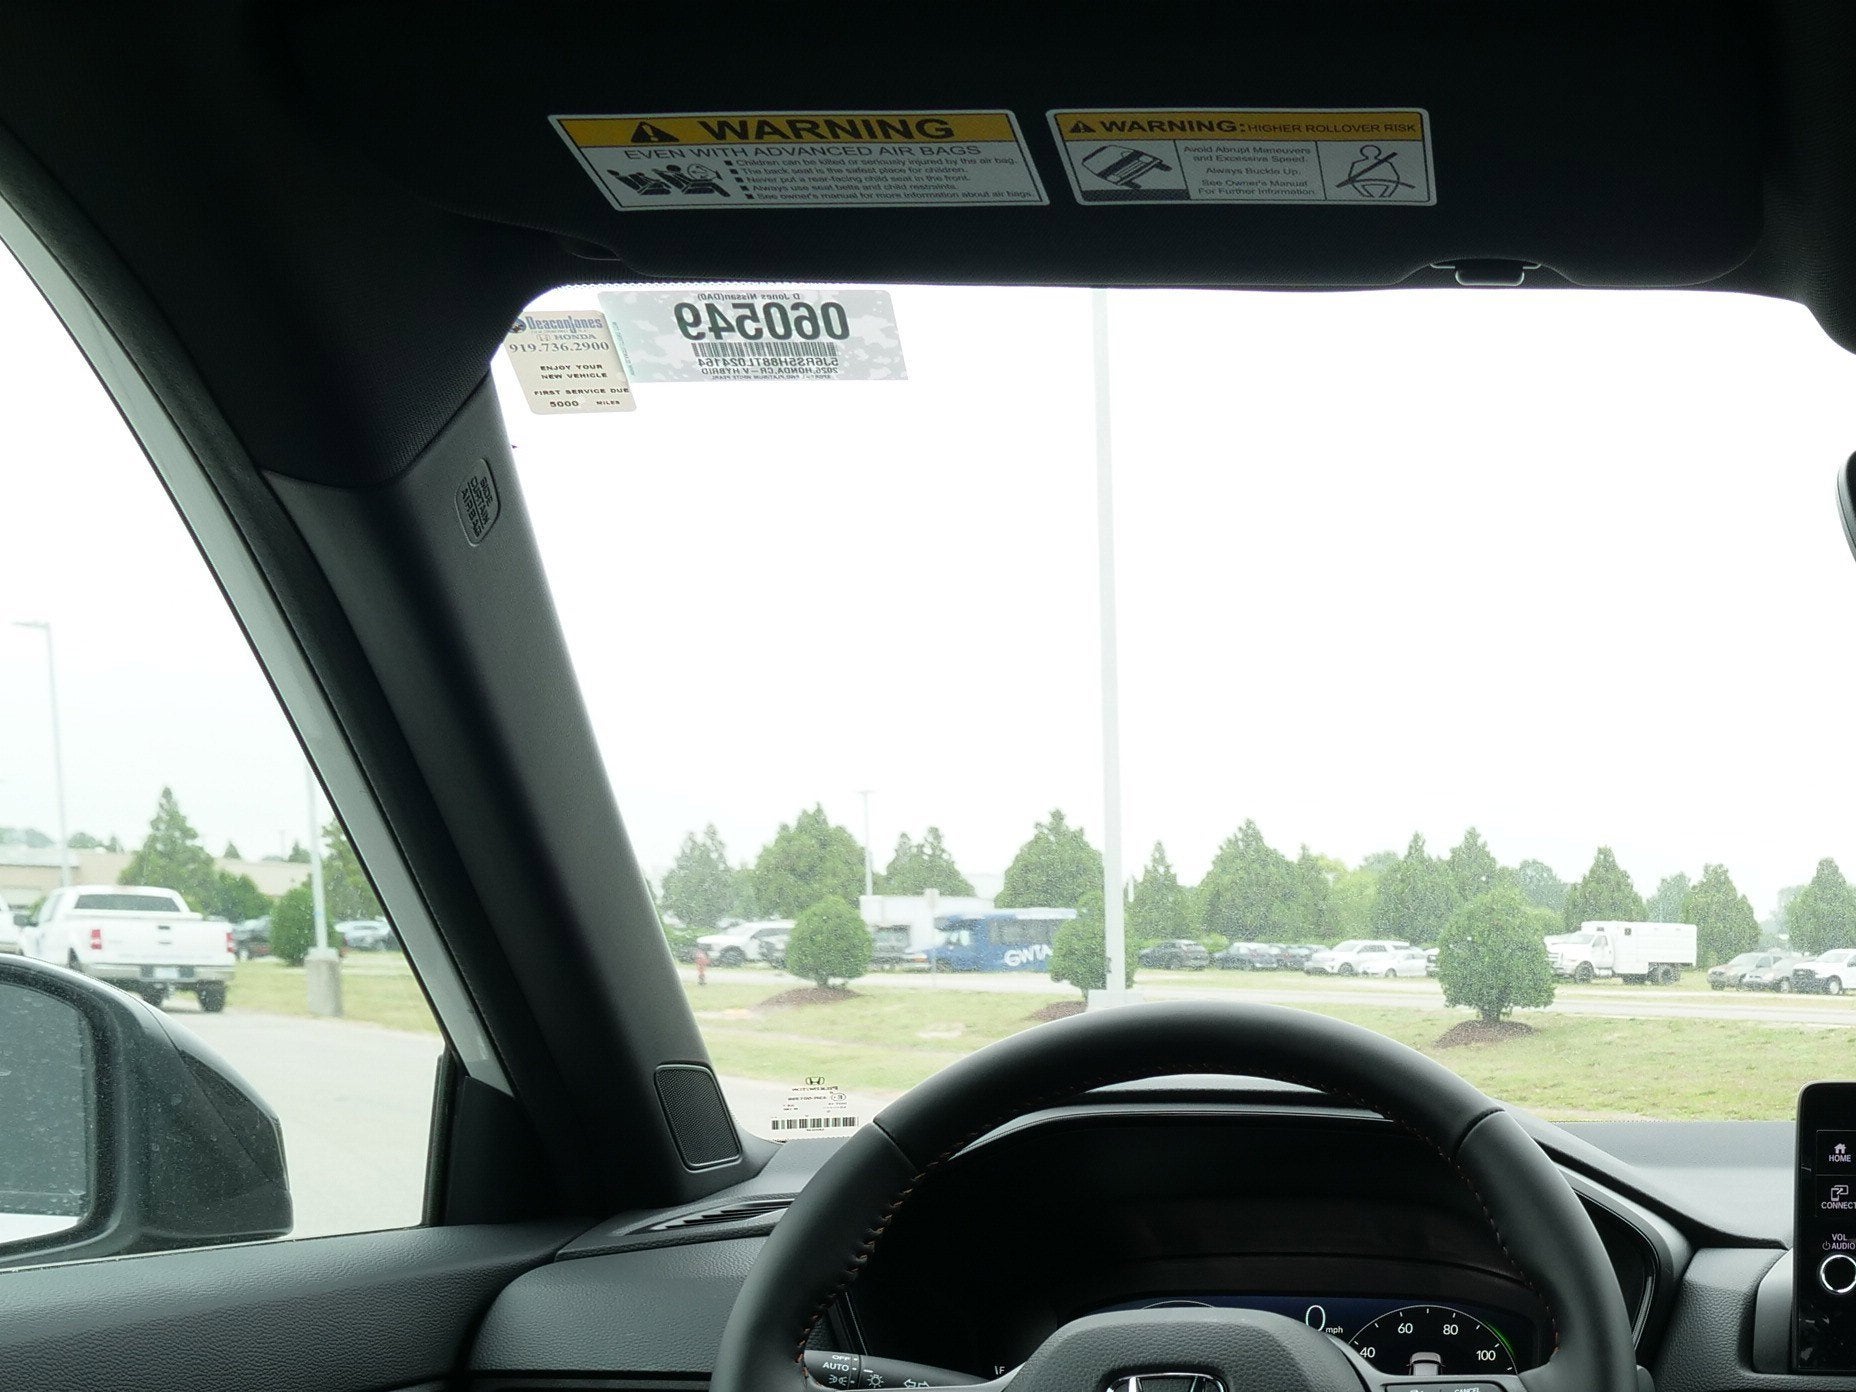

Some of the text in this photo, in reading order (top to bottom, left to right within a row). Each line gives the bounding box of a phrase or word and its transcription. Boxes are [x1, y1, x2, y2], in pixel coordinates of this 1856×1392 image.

[697, 118, 955, 141] WARNING
[1100, 119, 1416, 133] WARNING: HIGHER ROLLOVER RISK
[624, 145, 982, 160] EVEN WITH ADVANCED AIR BAGS
[509, 341, 610, 353] 919.736.2900
[549, 400, 579, 408] 5000
[1828, 1154, 1852, 1163] HOME
[1831, 1233, 1848, 1242] VOL
[1831, 1242, 1856, 1250] AUDIO
[1306, 1304, 1343, 1334] 0 mph
[1398, 1322, 1413, 1334] 60
[1443, 1324, 1458, 1335] 80
[1359, 1347, 1376, 1358] 40
[1475, 1350, 1496, 1361] 100
[822, 1361, 850, 1372] AUTO
